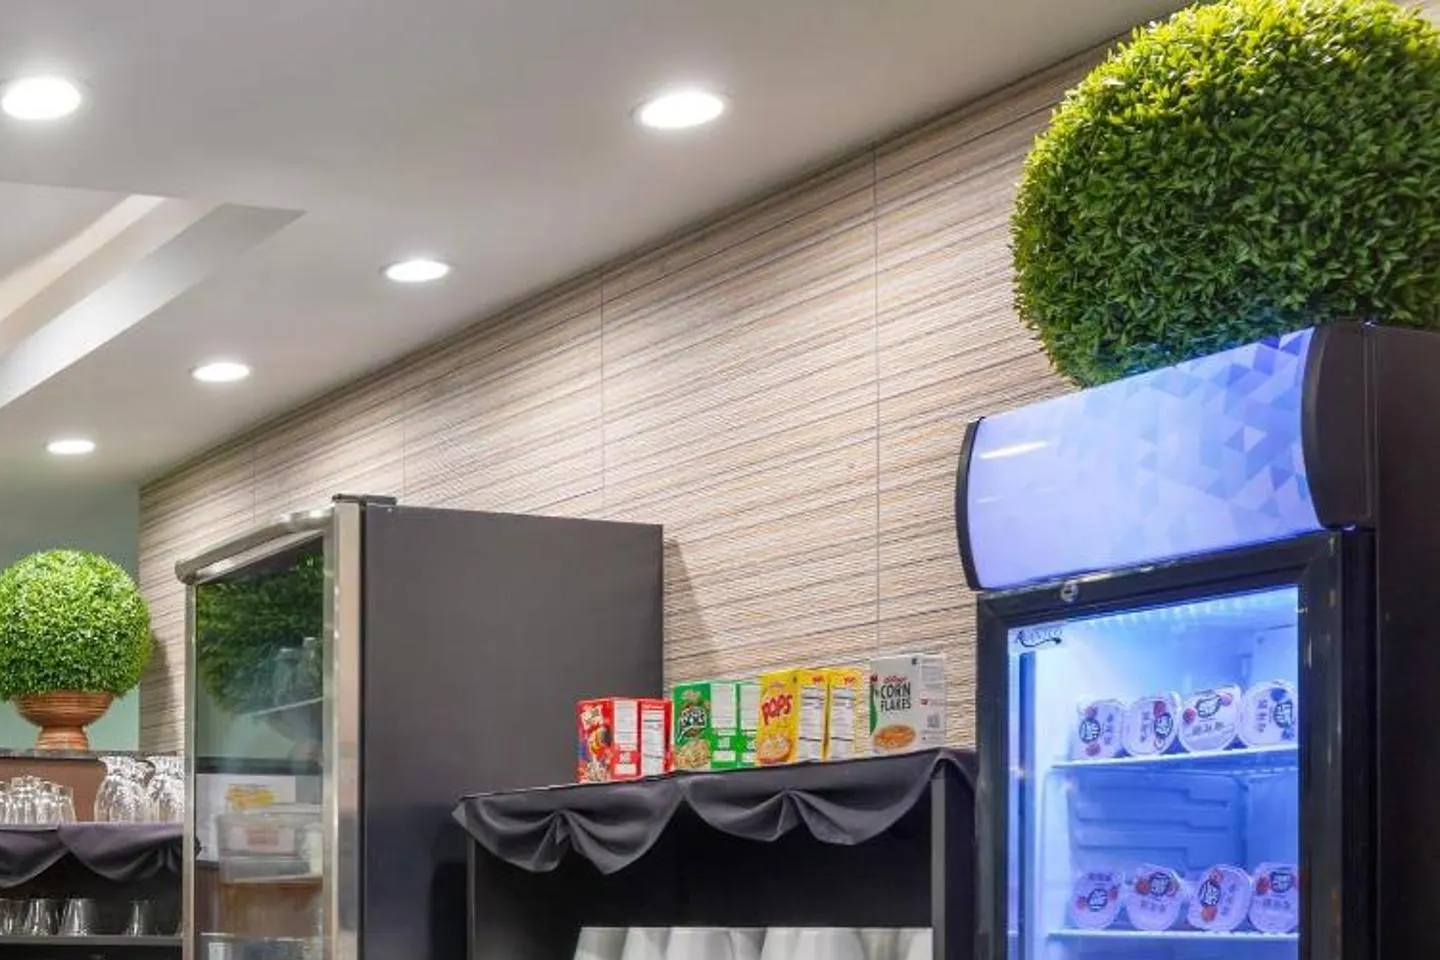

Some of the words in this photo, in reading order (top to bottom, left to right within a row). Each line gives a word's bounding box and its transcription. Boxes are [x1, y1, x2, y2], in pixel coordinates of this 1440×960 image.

[880, 681, 911, 699] CORN
[762, 694, 792, 725] POPS
[880, 699, 911, 712] FLAKES
